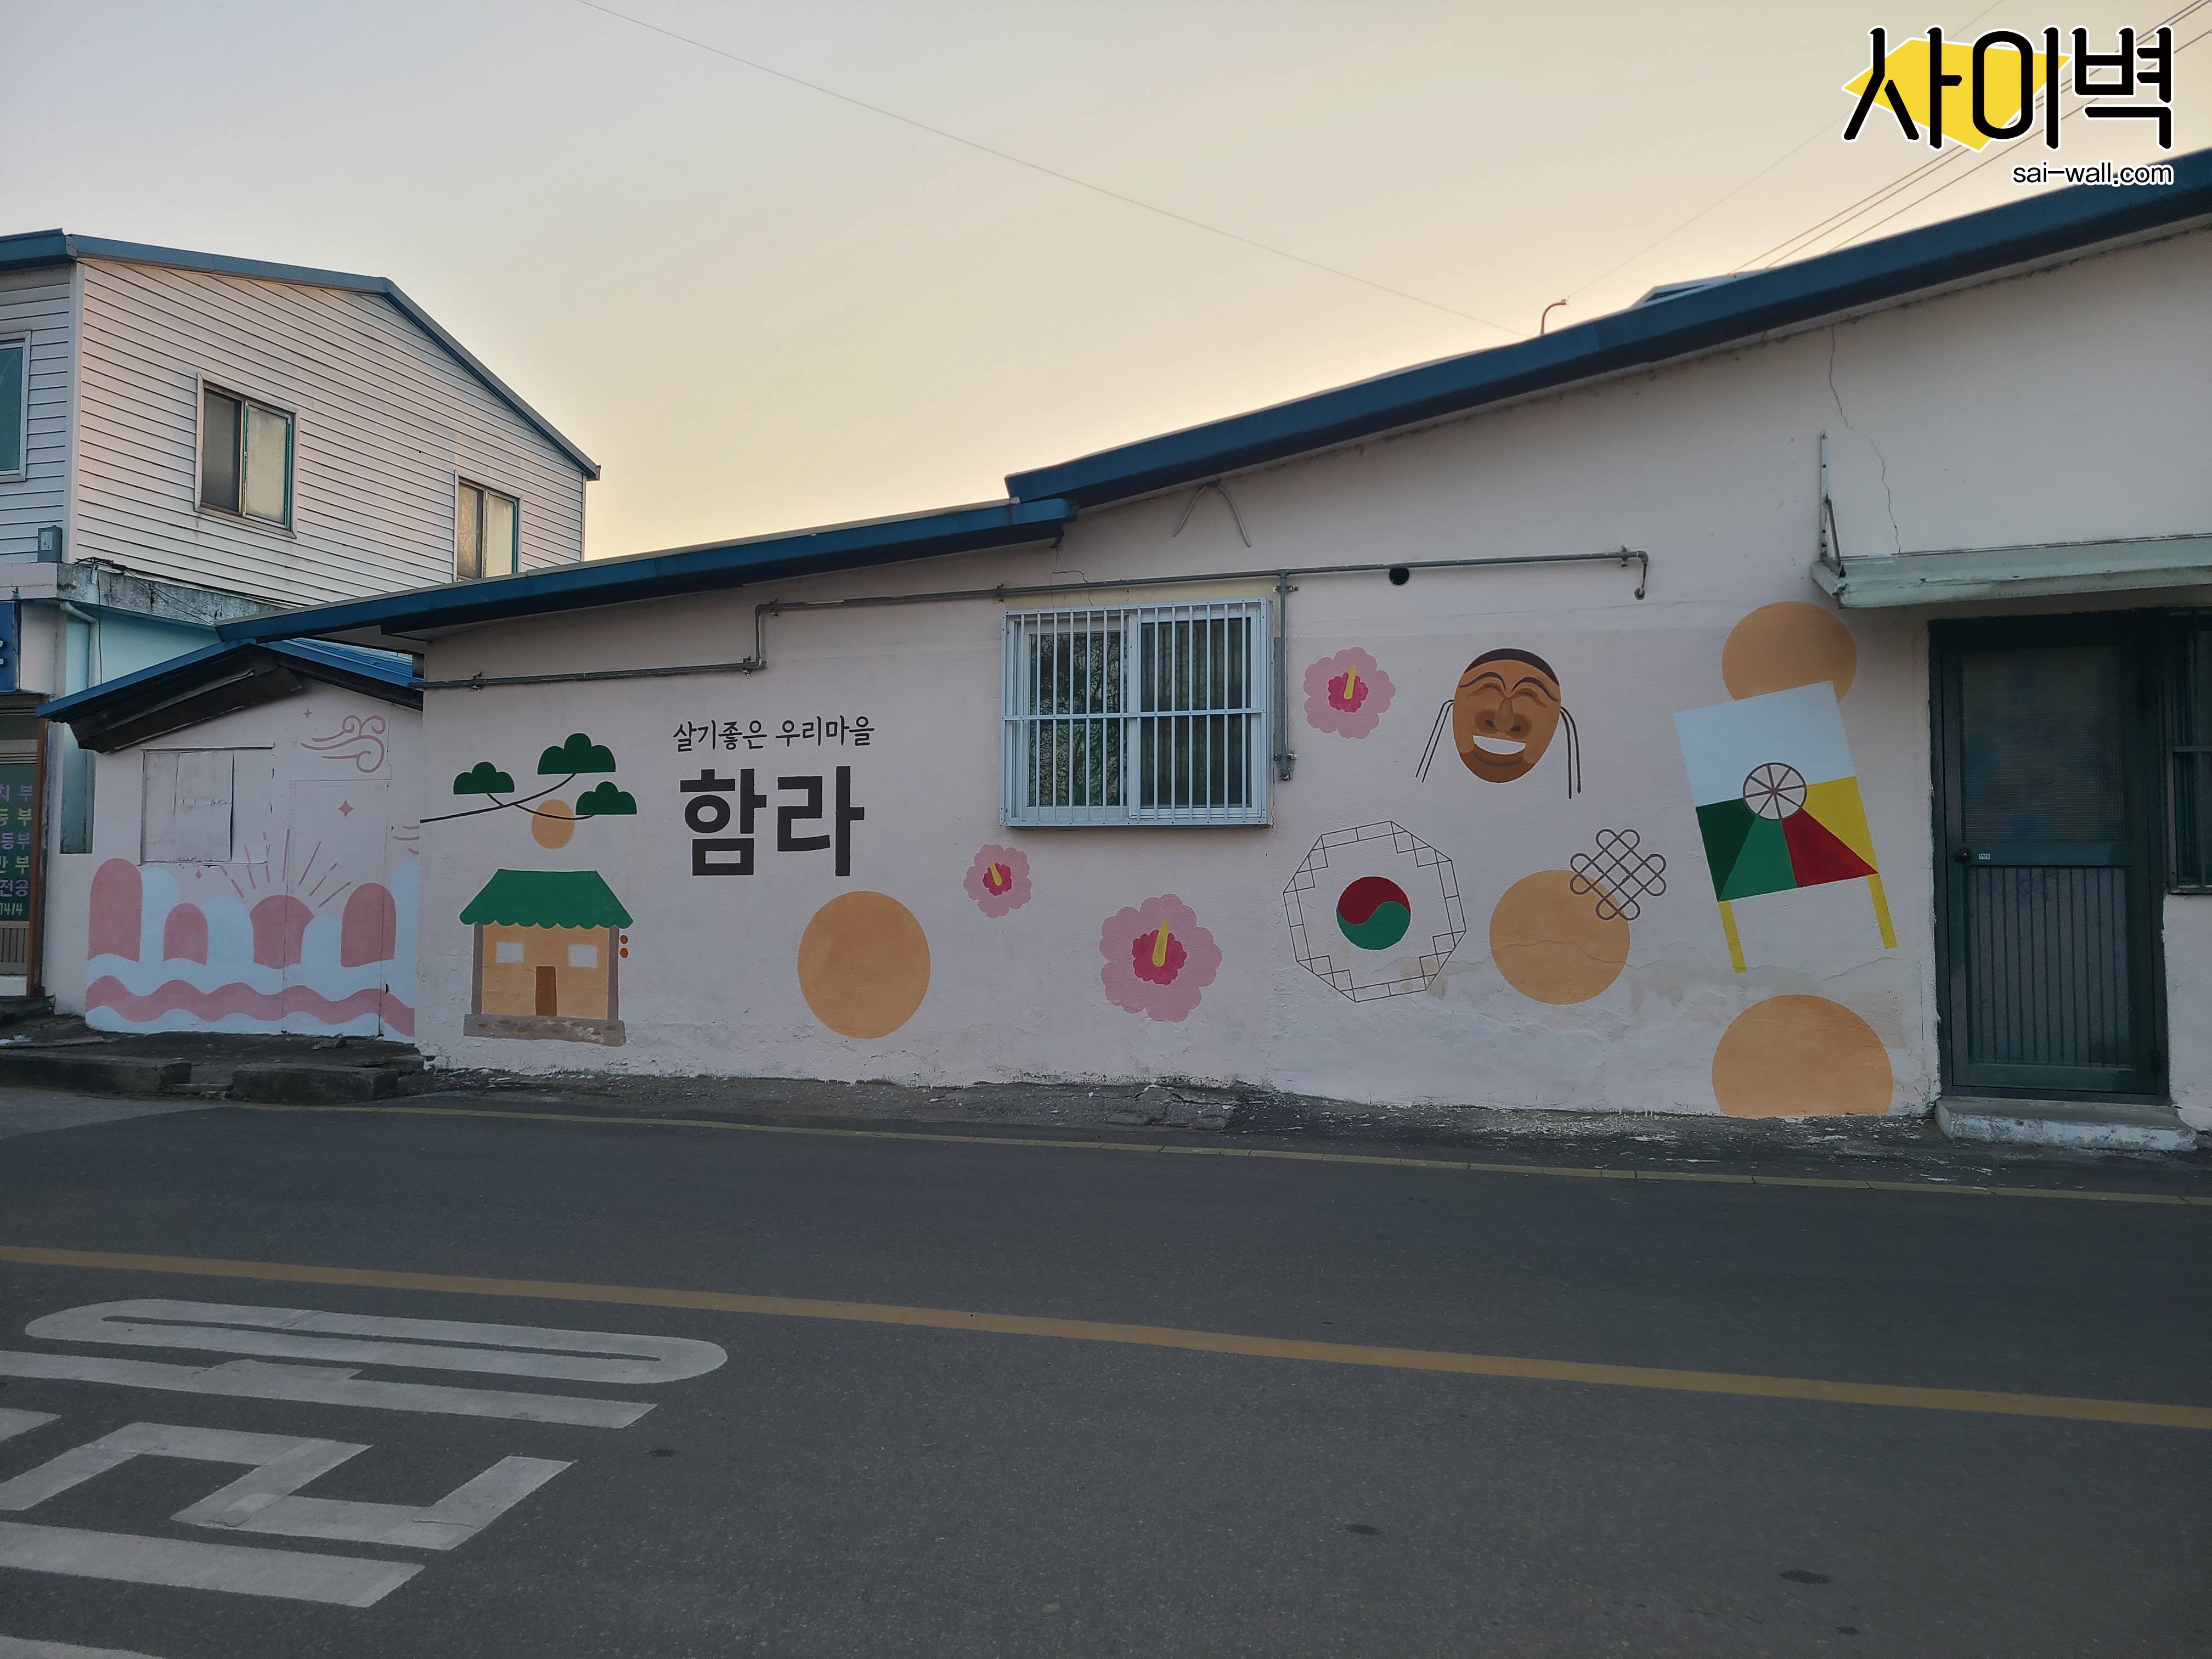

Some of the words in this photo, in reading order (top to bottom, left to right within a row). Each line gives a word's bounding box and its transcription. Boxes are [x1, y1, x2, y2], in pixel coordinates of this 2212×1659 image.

[673, 720, 768, 752] 살기좋은
[775, 715, 875, 747] 우리마을
[680, 765, 865, 877] 함라
